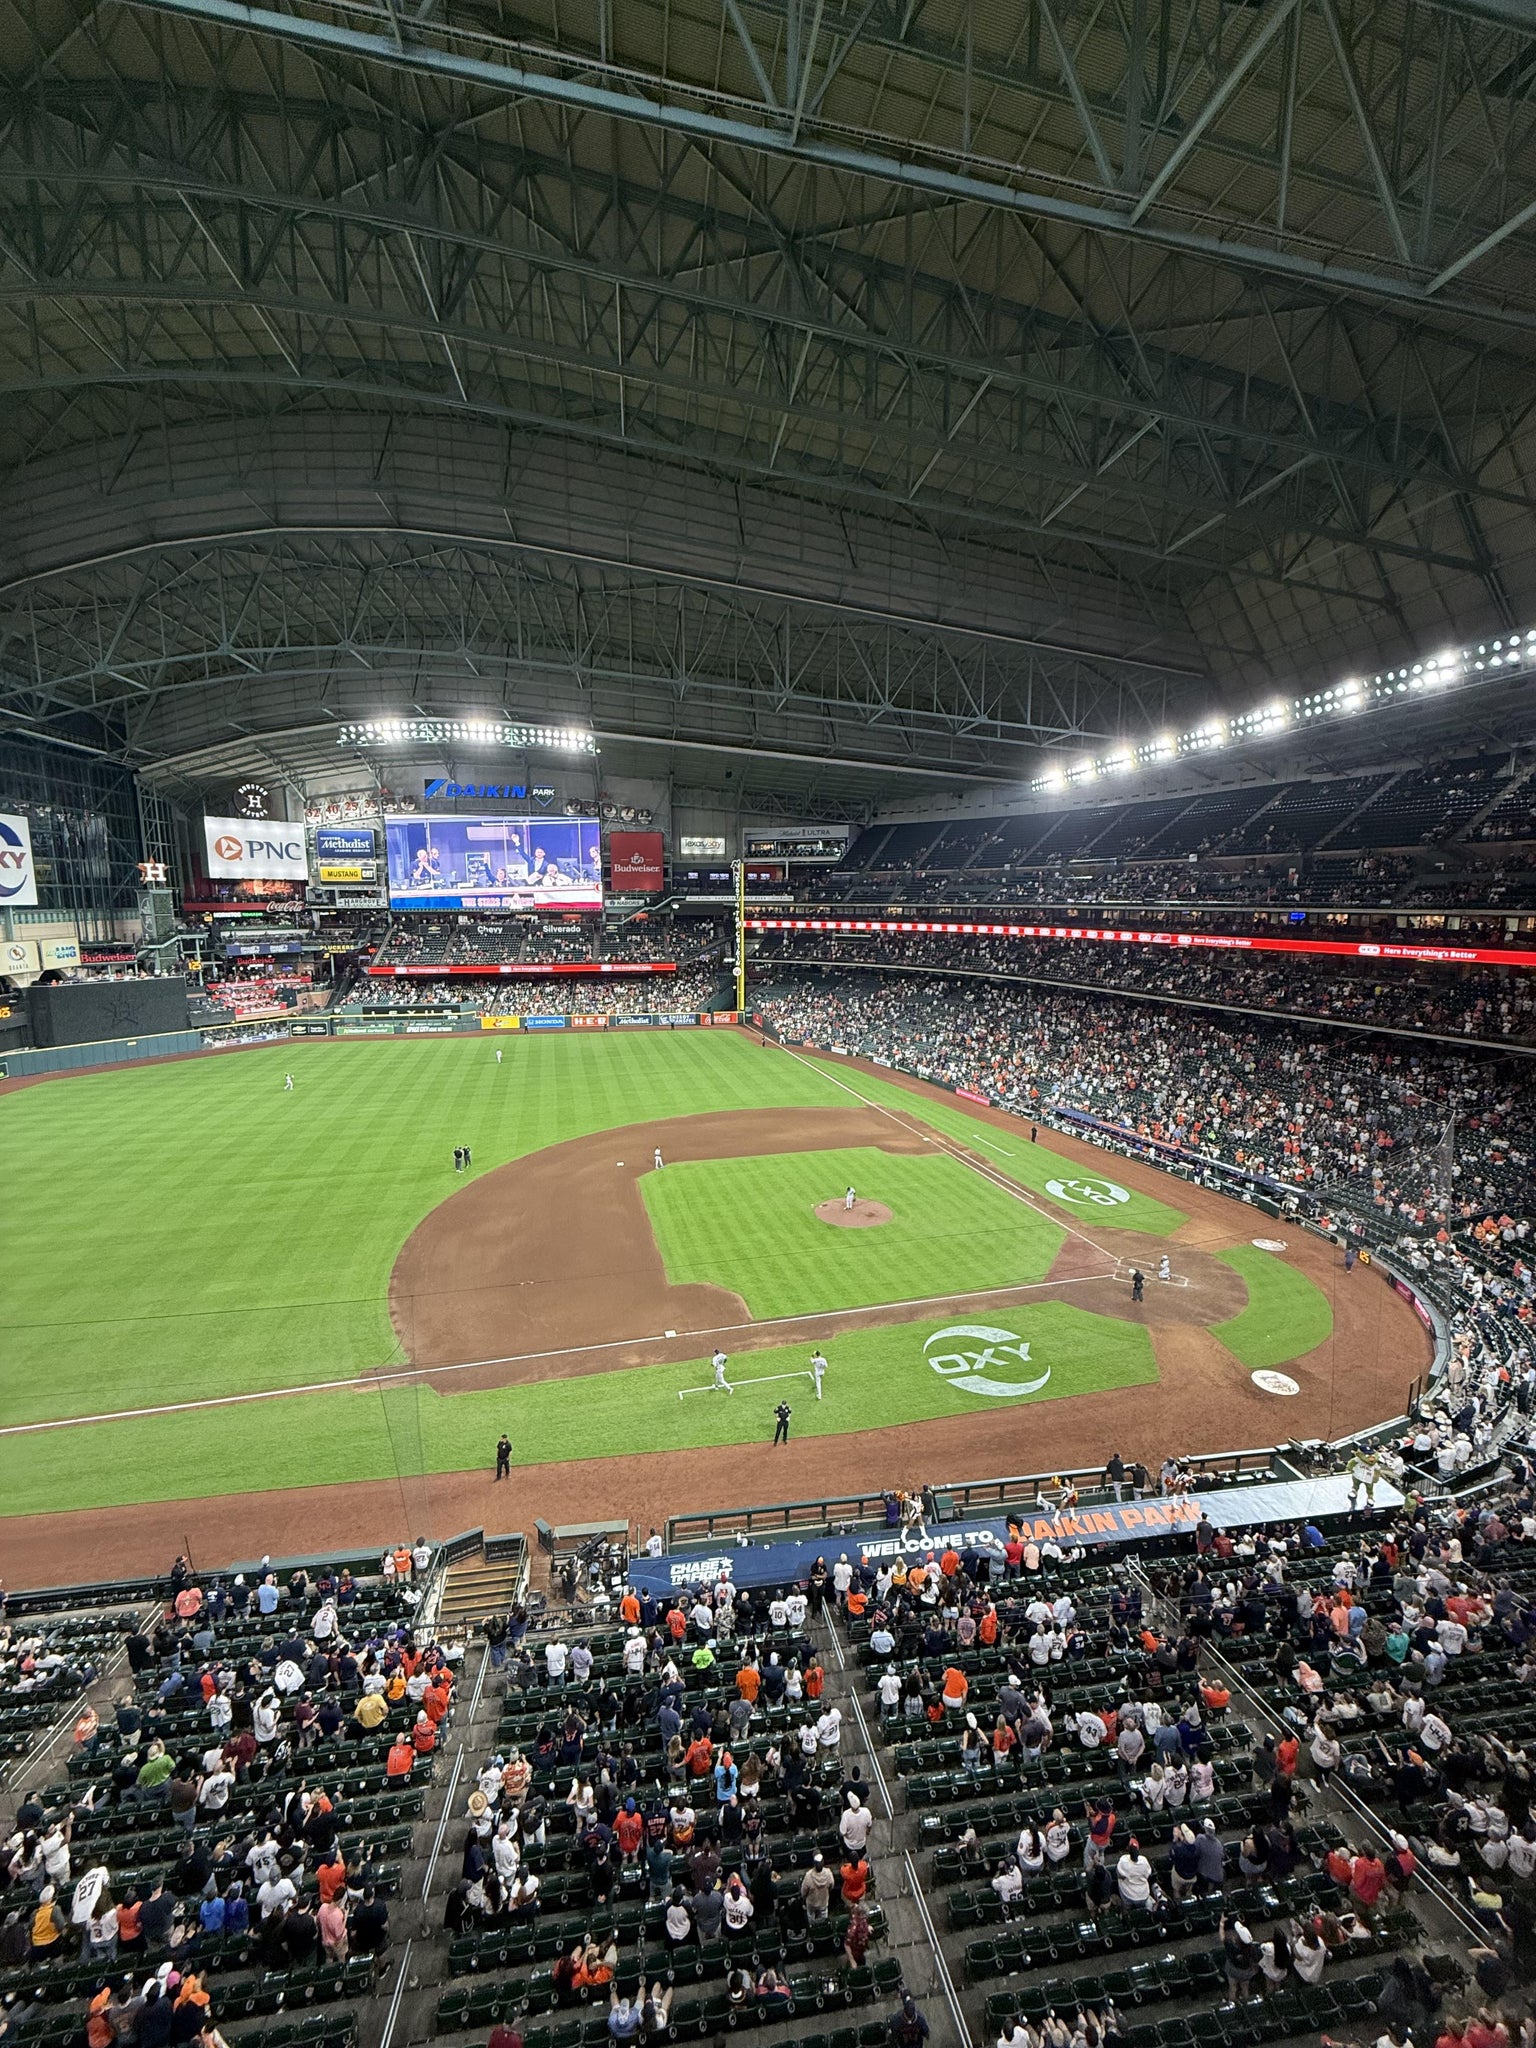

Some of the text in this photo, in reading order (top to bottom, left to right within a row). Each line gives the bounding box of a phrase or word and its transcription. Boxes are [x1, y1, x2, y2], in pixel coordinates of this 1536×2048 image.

[446, 784, 555, 798] DAIKIN PARK
[248, 795, 262, 808] H
[321, 838, 370, 849] Methodist
[245, 840, 302, 860] PNC
[139, 862, 166, 881] H
[614, 864, 660, 873] Budweiser
[477, 925, 503, 934] Chevy
[543, 925, 581, 933] Silverado
[81, 953, 137, 962] Budweiser
[1403, 948, 1449, 960] Everything's
[1450, 951, 1477, 959] Better
[619, 1016, 649, 1024] Methodist
[927, 1342, 1033, 1375] OXY
[861, 1535, 958, 1558] WELCOME
[963, 1530, 994, 1546] TO
[1119, 1501, 1203, 1529] PARK
[670, 1561, 719, 1575] CHASE
[322, 1612, 328, 1621] 2
[774, 1611, 783, 1619] 10
[283, 1664, 295, 1677] 27
[1086, 1726, 1098, 1737] 43
[539, 1742, 553, 1754] 27
[650, 1825, 663, 1836] 27
[256, 1856, 270, 1870] 45
[79, 1881, 96, 1902] 27
[94, 1928, 102, 1938] 3
